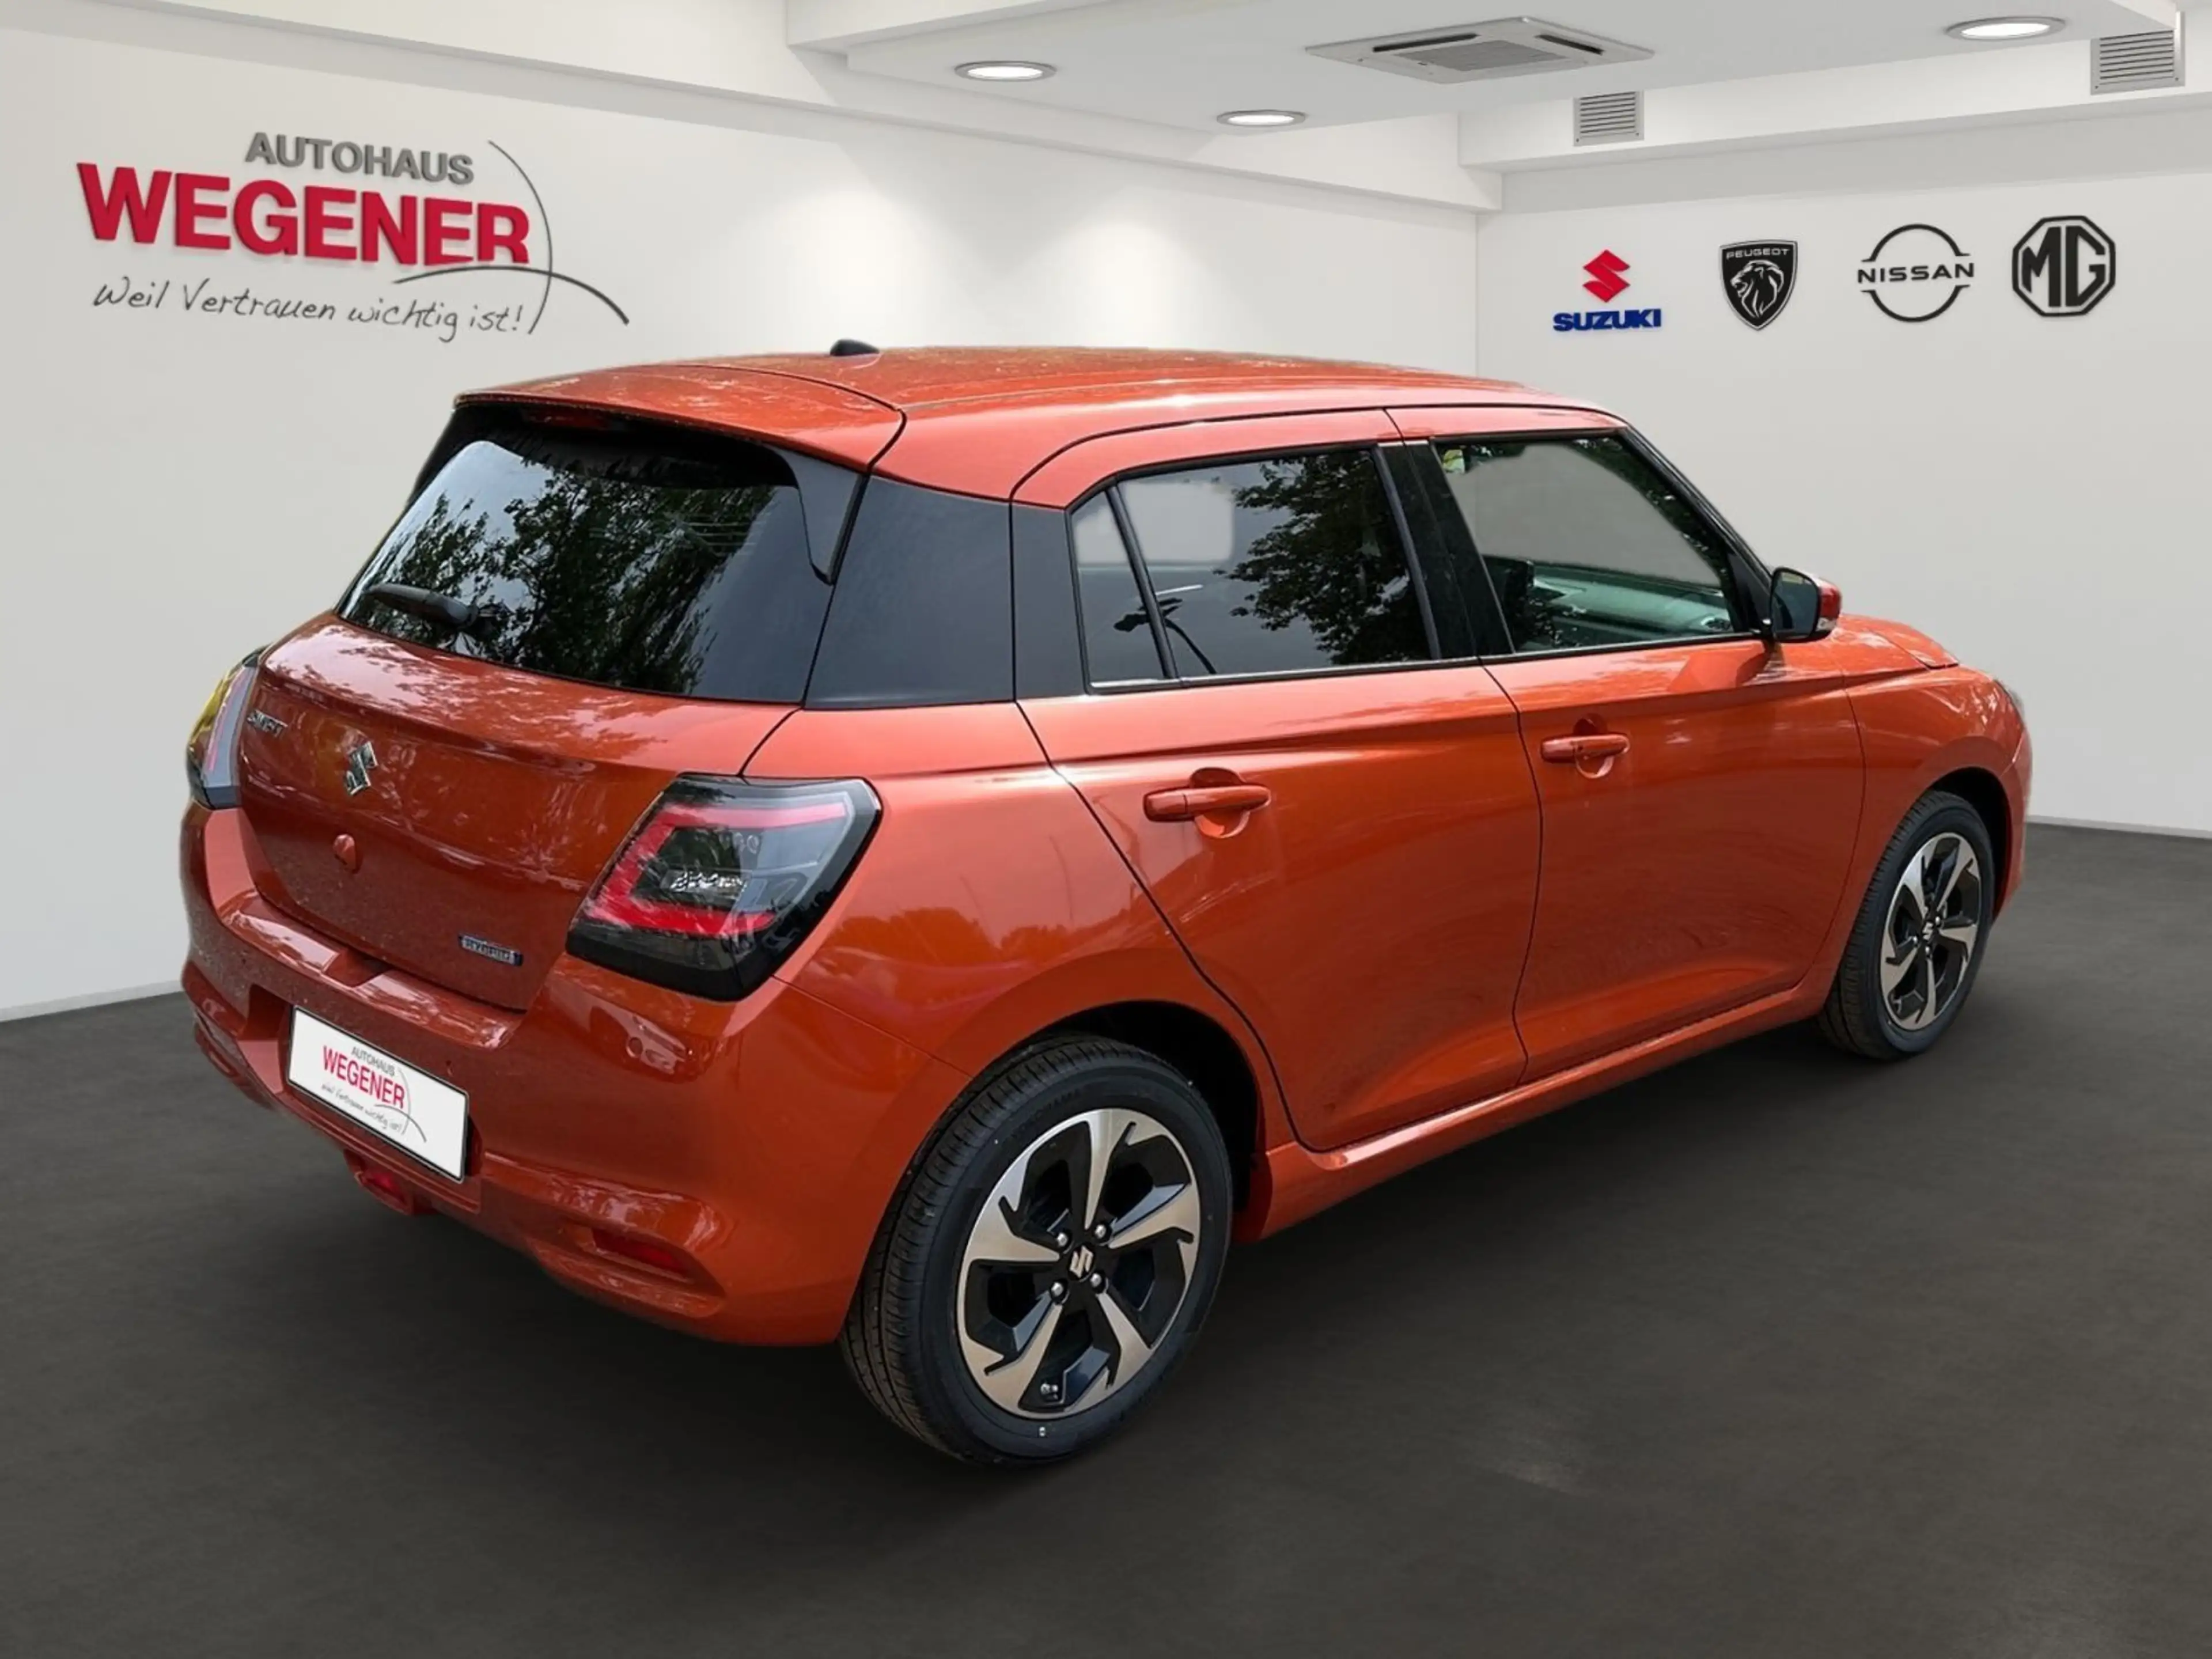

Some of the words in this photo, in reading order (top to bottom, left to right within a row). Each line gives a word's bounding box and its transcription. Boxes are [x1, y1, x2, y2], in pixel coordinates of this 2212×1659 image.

[245, 132, 473, 184] AUTOHAUS
[77, 162, 531, 266] WEGENER
[1726, 247, 1791, 259] PEUGEOT
[1857, 263, 1974, 283] NISSAN
[2021, 225, 2106, 307] MG
[93, 276, 169, 309] Weil
[183, 278, 336, 320] Vertrauen
[347, 298, 458, 343] wichtig
[470, 304, 523, 332] ist!
[1552, 308, 1662, 332] SUZUKI
[323, 1046, 405, 1109] WEGENER
[351, 1046, 396, 1077] AUTOHAUS
